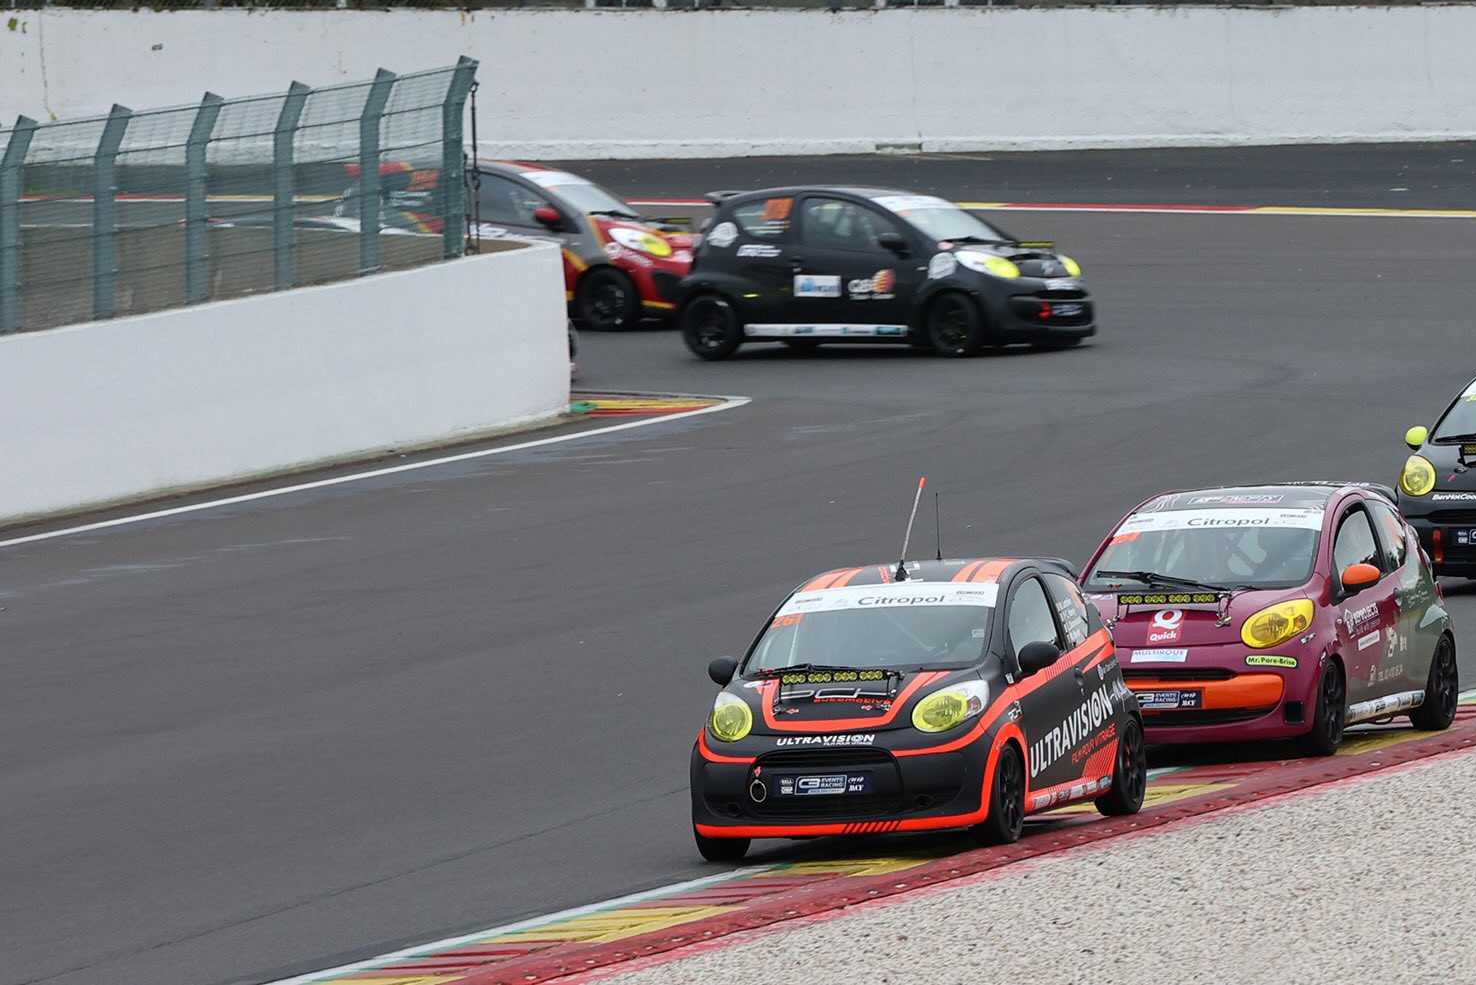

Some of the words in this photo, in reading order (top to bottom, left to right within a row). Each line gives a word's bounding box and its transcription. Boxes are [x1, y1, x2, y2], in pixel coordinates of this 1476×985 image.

[1188, 517, 1270, 527] Citropol
[857, 594, 945, 606] Citropol
[1150, 631, 1177, 642] Quick
[1261, 658, 1296, 666] Pare-Brise
[1030, 684, 1114, 778] ULTRAVISION
[776, 734, 876, 746] ULTRAVISION
